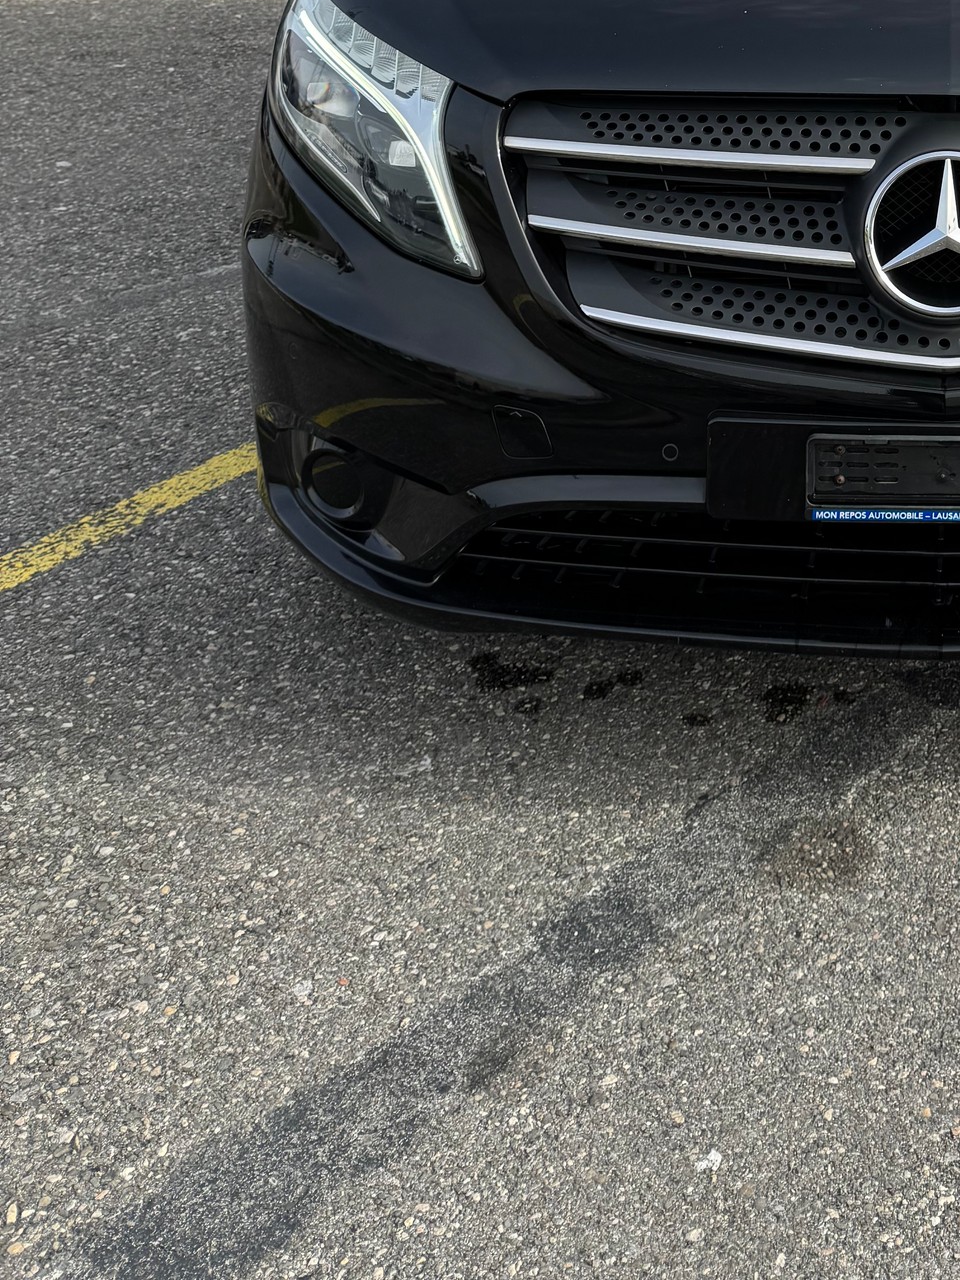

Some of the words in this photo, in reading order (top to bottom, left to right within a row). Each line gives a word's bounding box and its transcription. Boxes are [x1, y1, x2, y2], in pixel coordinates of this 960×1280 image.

[815, 511, 838, 519] MON
[840, 511, 866, 519] REPOS
[868, 511, 923, 520] AUTOMOBILE
